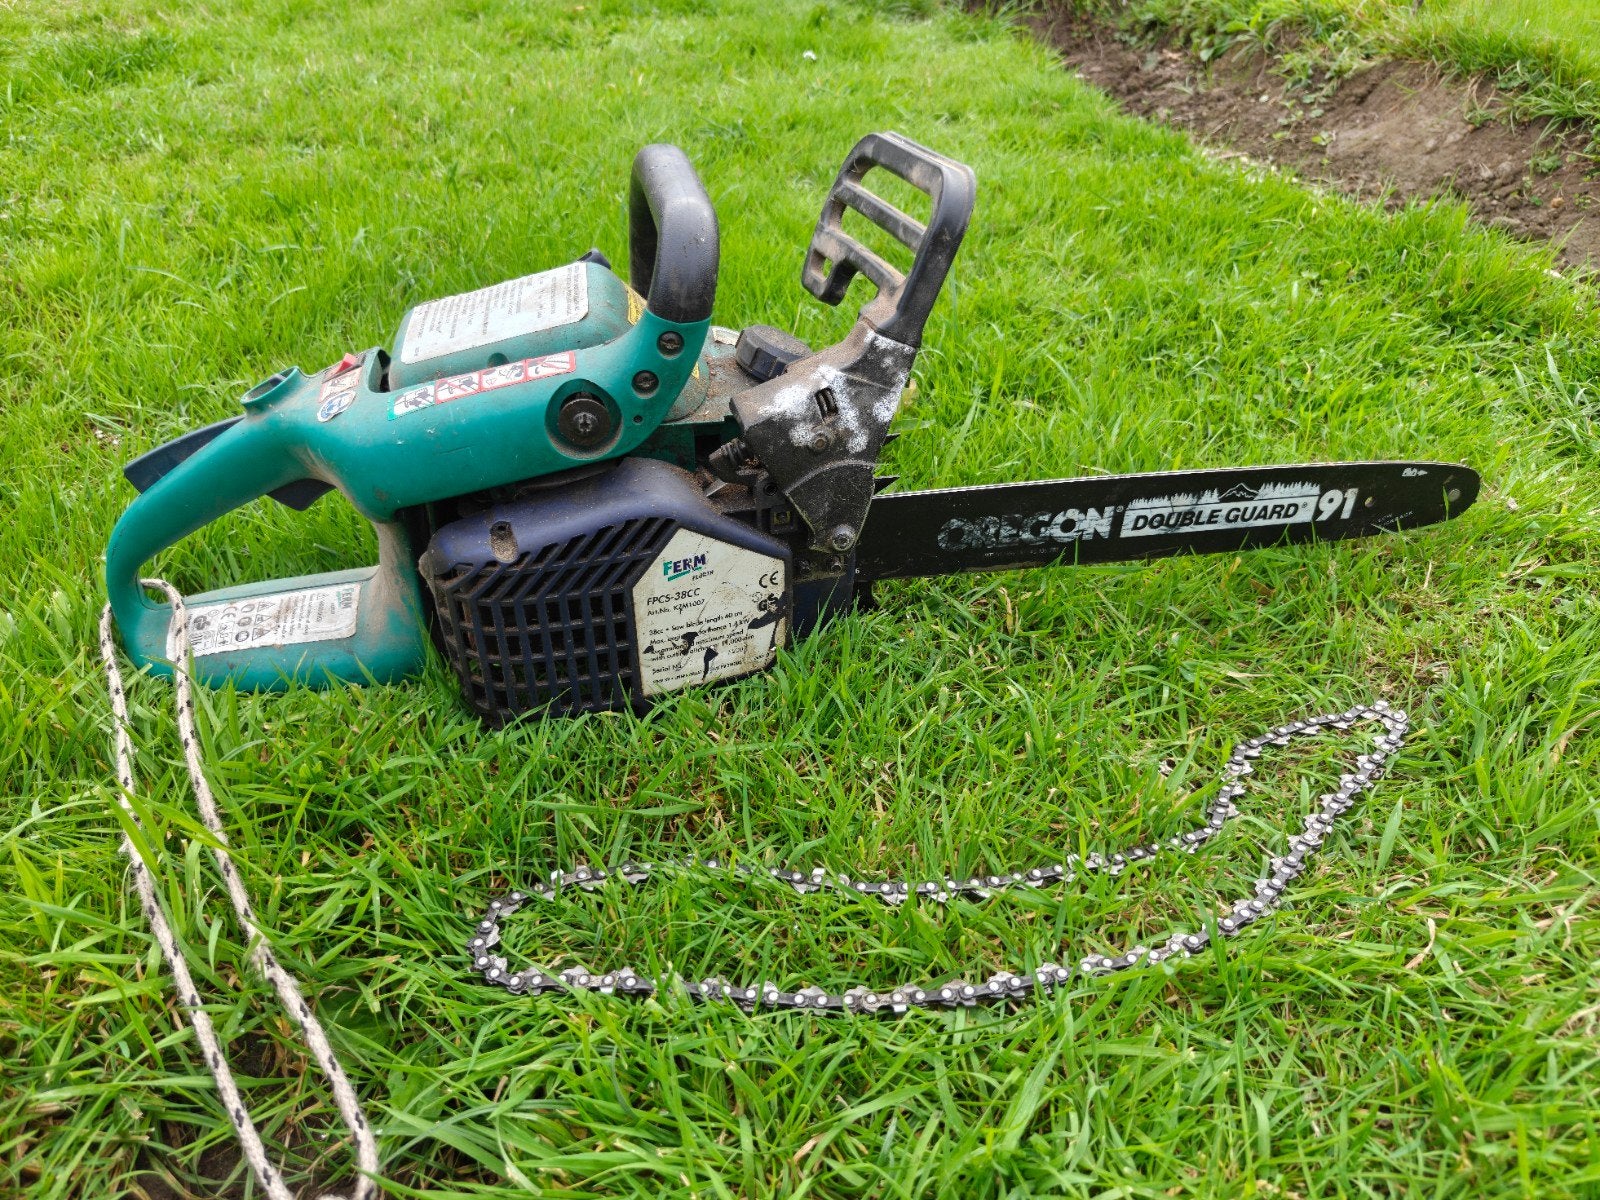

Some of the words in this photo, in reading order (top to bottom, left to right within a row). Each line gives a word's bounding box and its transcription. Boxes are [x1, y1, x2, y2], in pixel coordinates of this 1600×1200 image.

[1131, 509, 1222, 531] DOUBLE
[1225, 502, 1299, 524] GUARD
[1316, 487, 1359, 522] 91
[663, 553, 706, 576] FERM
[647, 587, 700, 606] FPCS-38CC
